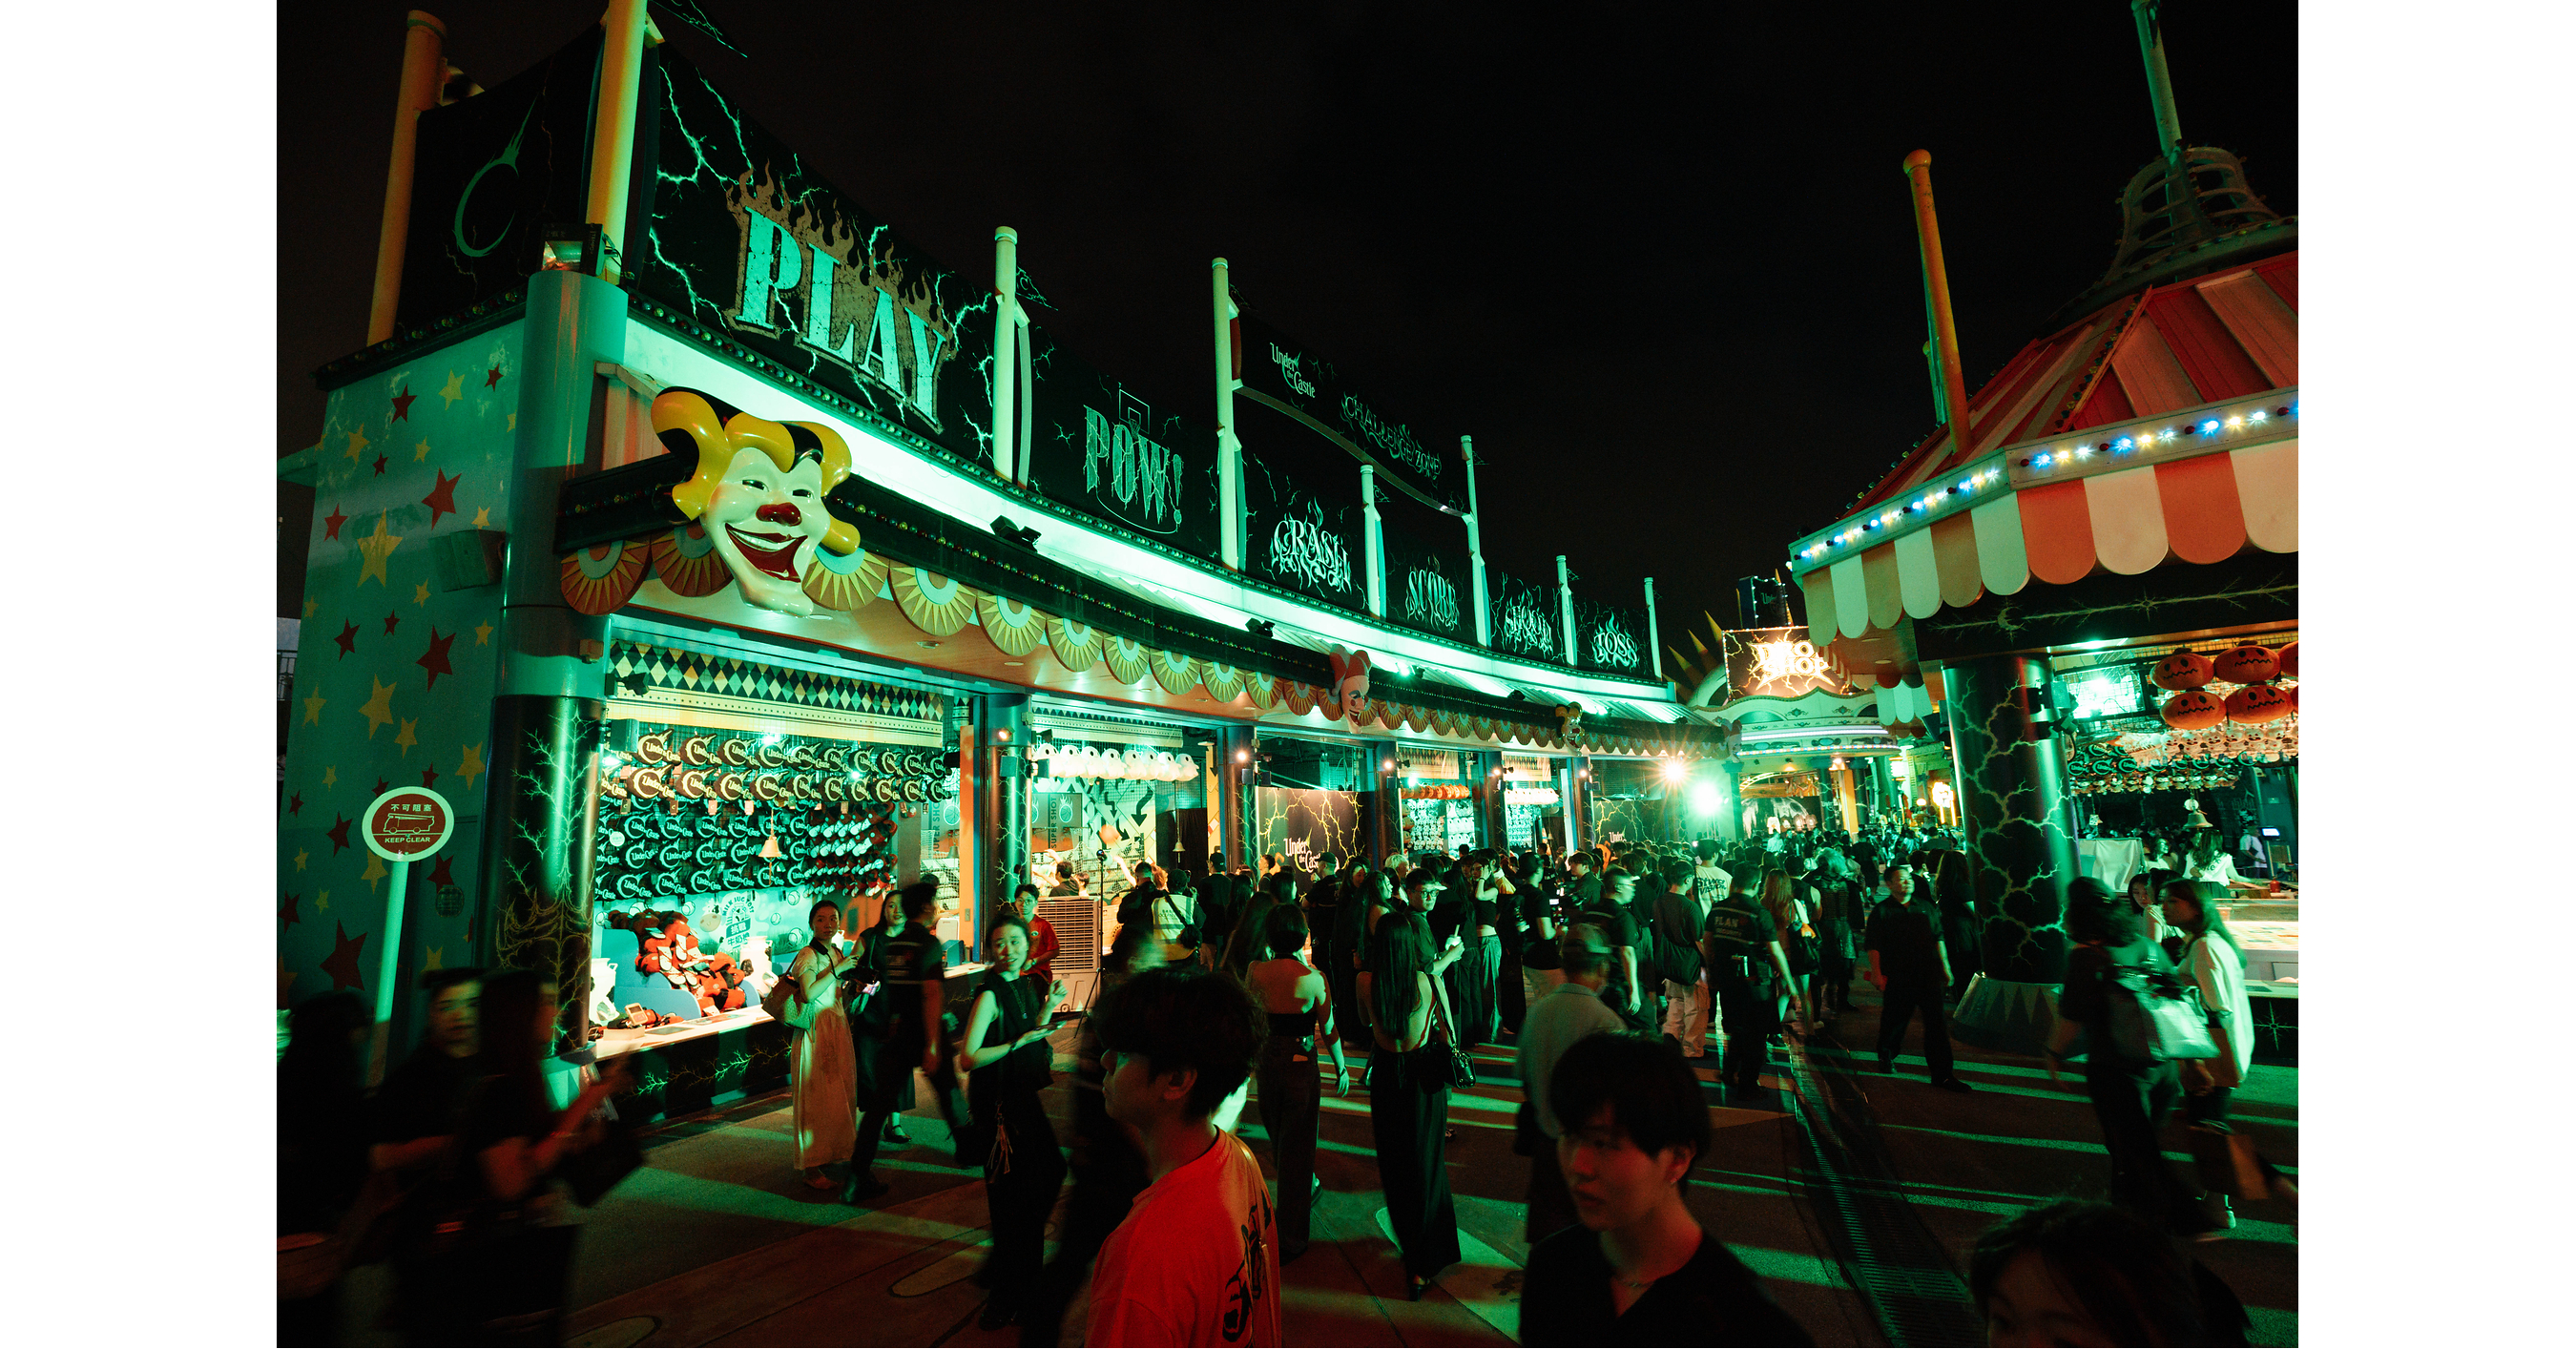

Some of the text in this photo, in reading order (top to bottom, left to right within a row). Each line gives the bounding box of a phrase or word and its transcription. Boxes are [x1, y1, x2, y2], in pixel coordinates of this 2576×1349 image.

[736, 205, 948, 426] PLAY
[1270, 342, 1296, 371] Under
[1294, 371, 1316, 399] Castle
[1342, 394, 1442, 477] CHALLENGE ZONE
[1083, 405, 1183, 525] POW!
[1272, 519, 1351, 591] CRASH
[1592, 630, 1638, 666] TOSS
[1756, 653, 1835, 689] SHOP
[391, 803, 431, 812] 不可阻塞
[1283, 838, 1307, 857] Under
[722, 900, 733, 916] MILK
